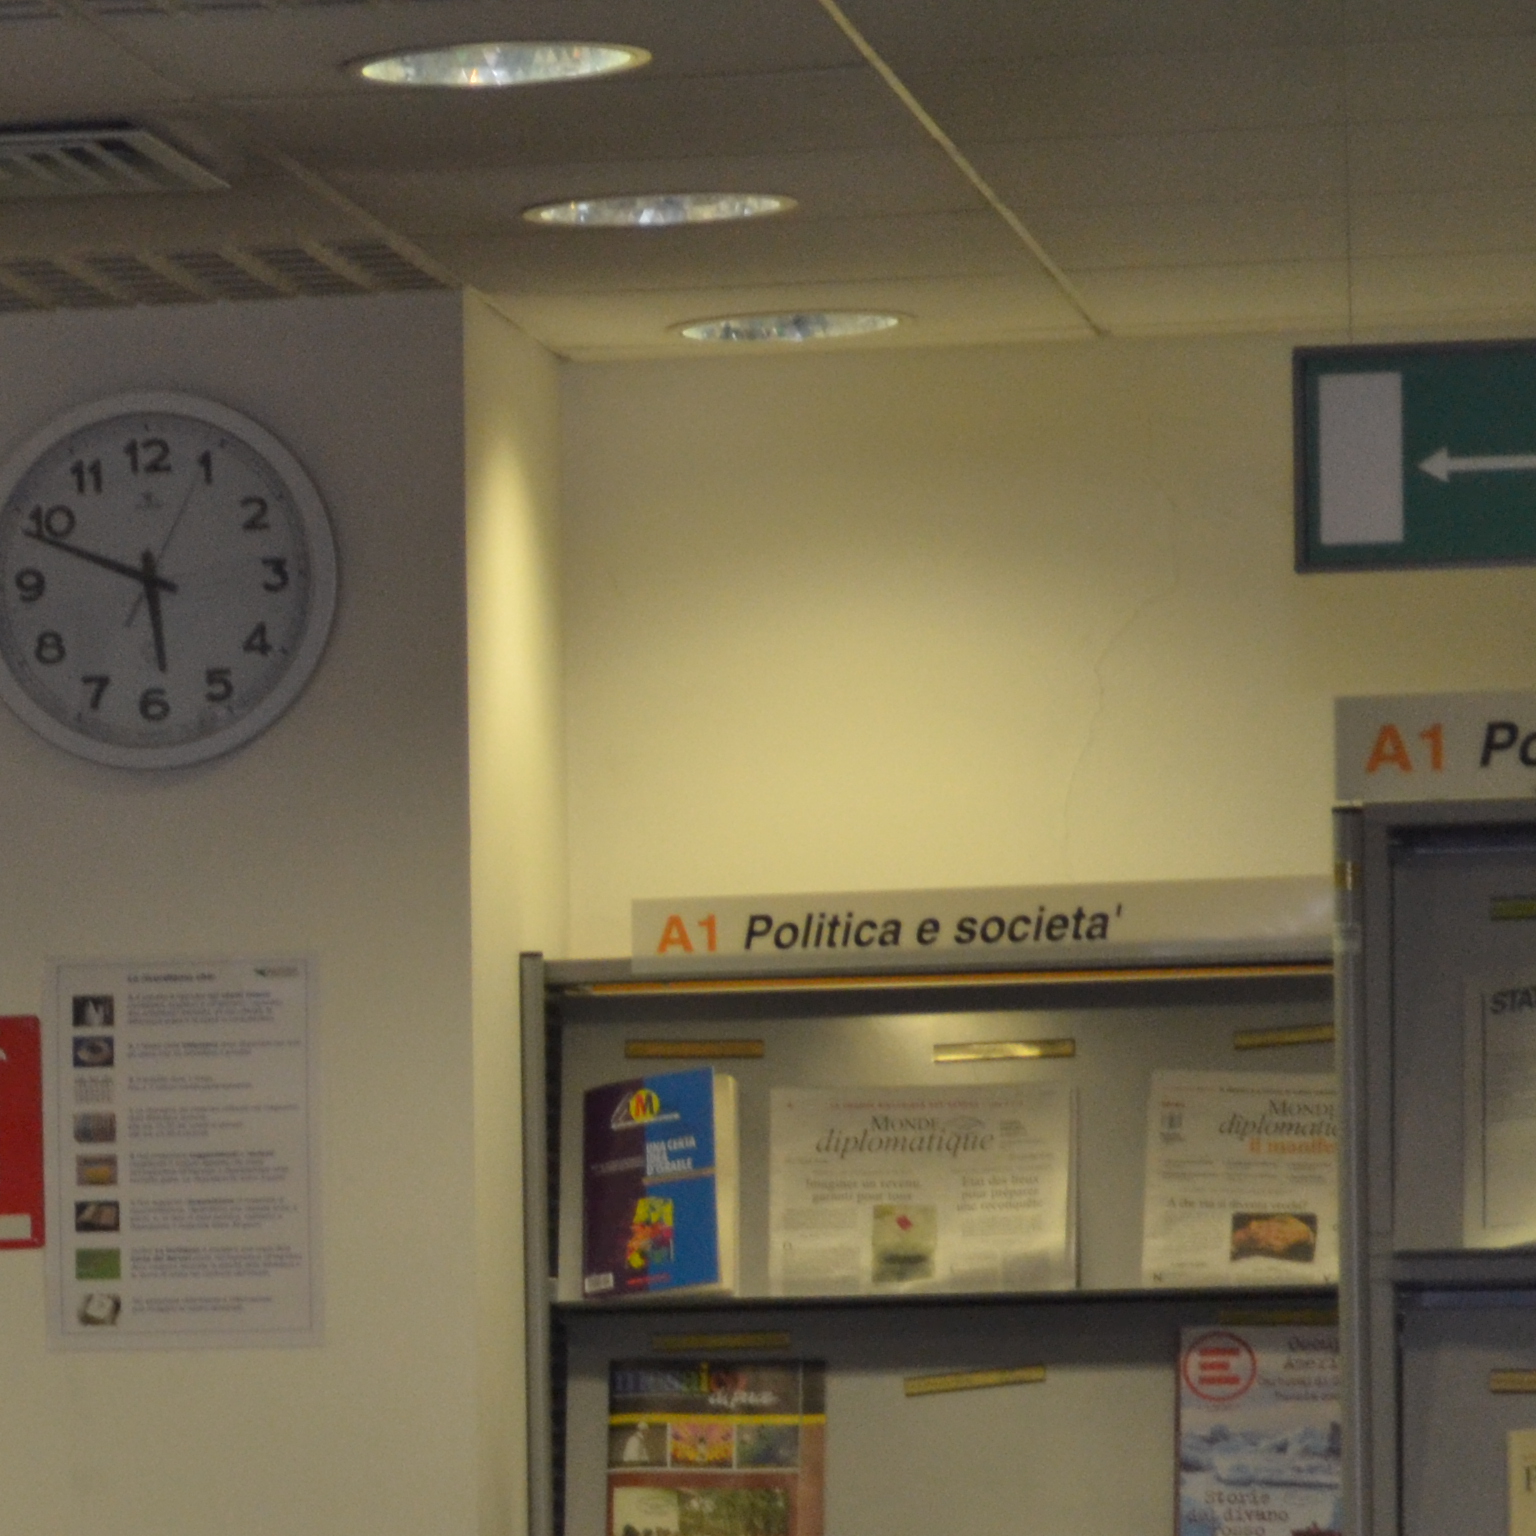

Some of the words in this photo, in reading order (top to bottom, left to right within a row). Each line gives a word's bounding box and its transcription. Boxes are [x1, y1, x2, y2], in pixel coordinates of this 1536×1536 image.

[124, 437, 171, 474] 12
[197, 450, 213, 485] 1
[70, 459, 102, 495] 11
[27, 504, 75, 539] 10
[240, 496, 270, 531] 2
[15, 567, 45, 602] 9
[261, 555, 289, 593] 3
[34, 630, 66, 665] 8
[242, 622, 272, 657] 4
[81, 675, 110, 710] 7
[205, 668, 234, 702] 5
[138, 687, 170, 722] 6
[1365, 722, 1445, 774] A1
[656, 913, 719, 956] A1
[743, 910, 902, 952] Politica
[916, 915, 941, 948] e
[952, 904, 1124, 945] societa'
[815, 1127, 995, 1158] diplomatique
[1224, 1506, 1289, 1523] divano
